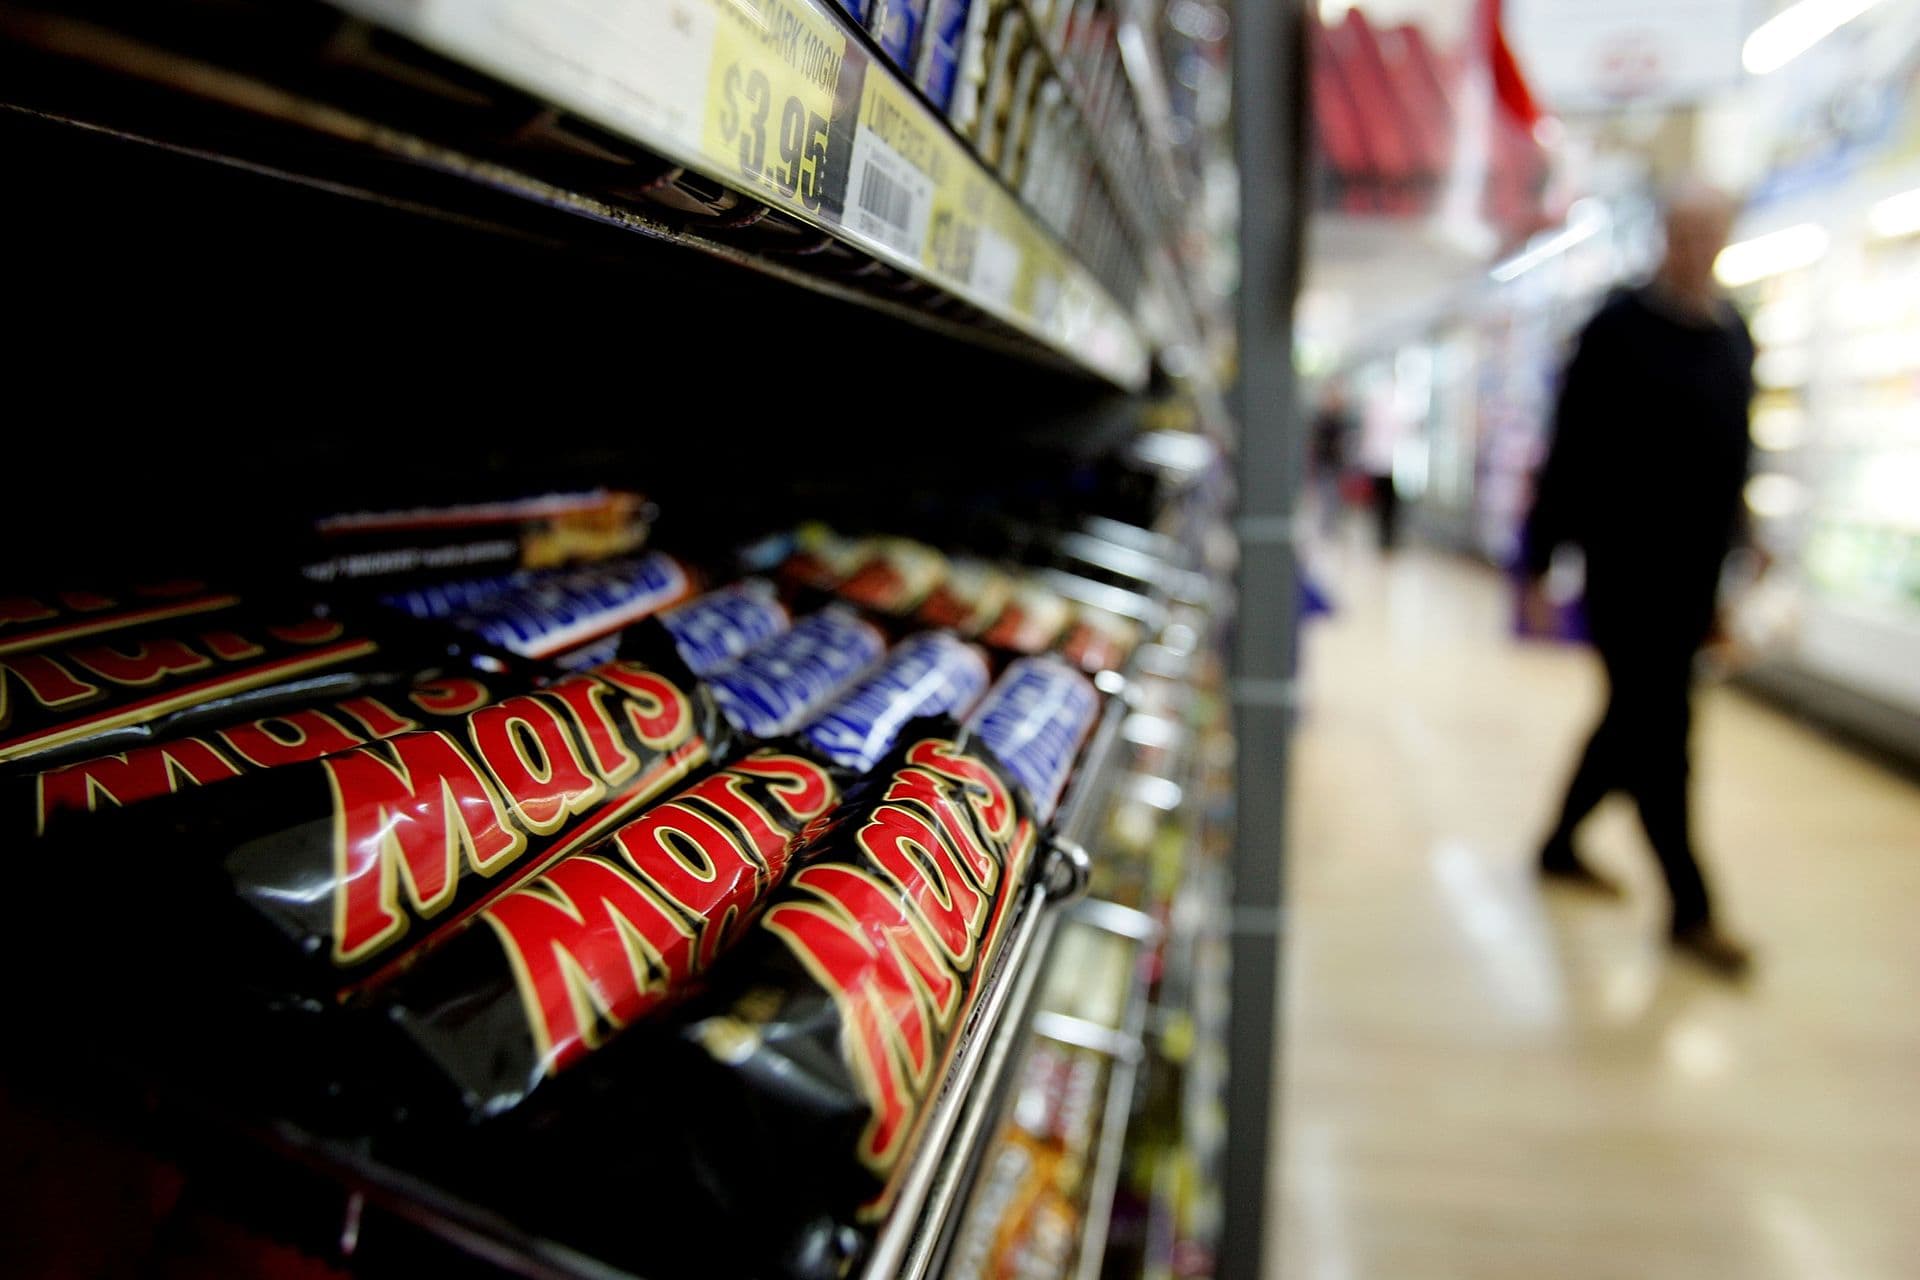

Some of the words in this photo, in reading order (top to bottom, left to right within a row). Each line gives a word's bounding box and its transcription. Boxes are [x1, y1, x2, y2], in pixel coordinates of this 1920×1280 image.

[720, 60, 828, 212] $3.95
[800, 29, 842, 99] 100GM
[321, 661, 696, 966] Mars
[483, 747, 837, 1076] Mars
[761, 736, 1015, 1172] Mars
